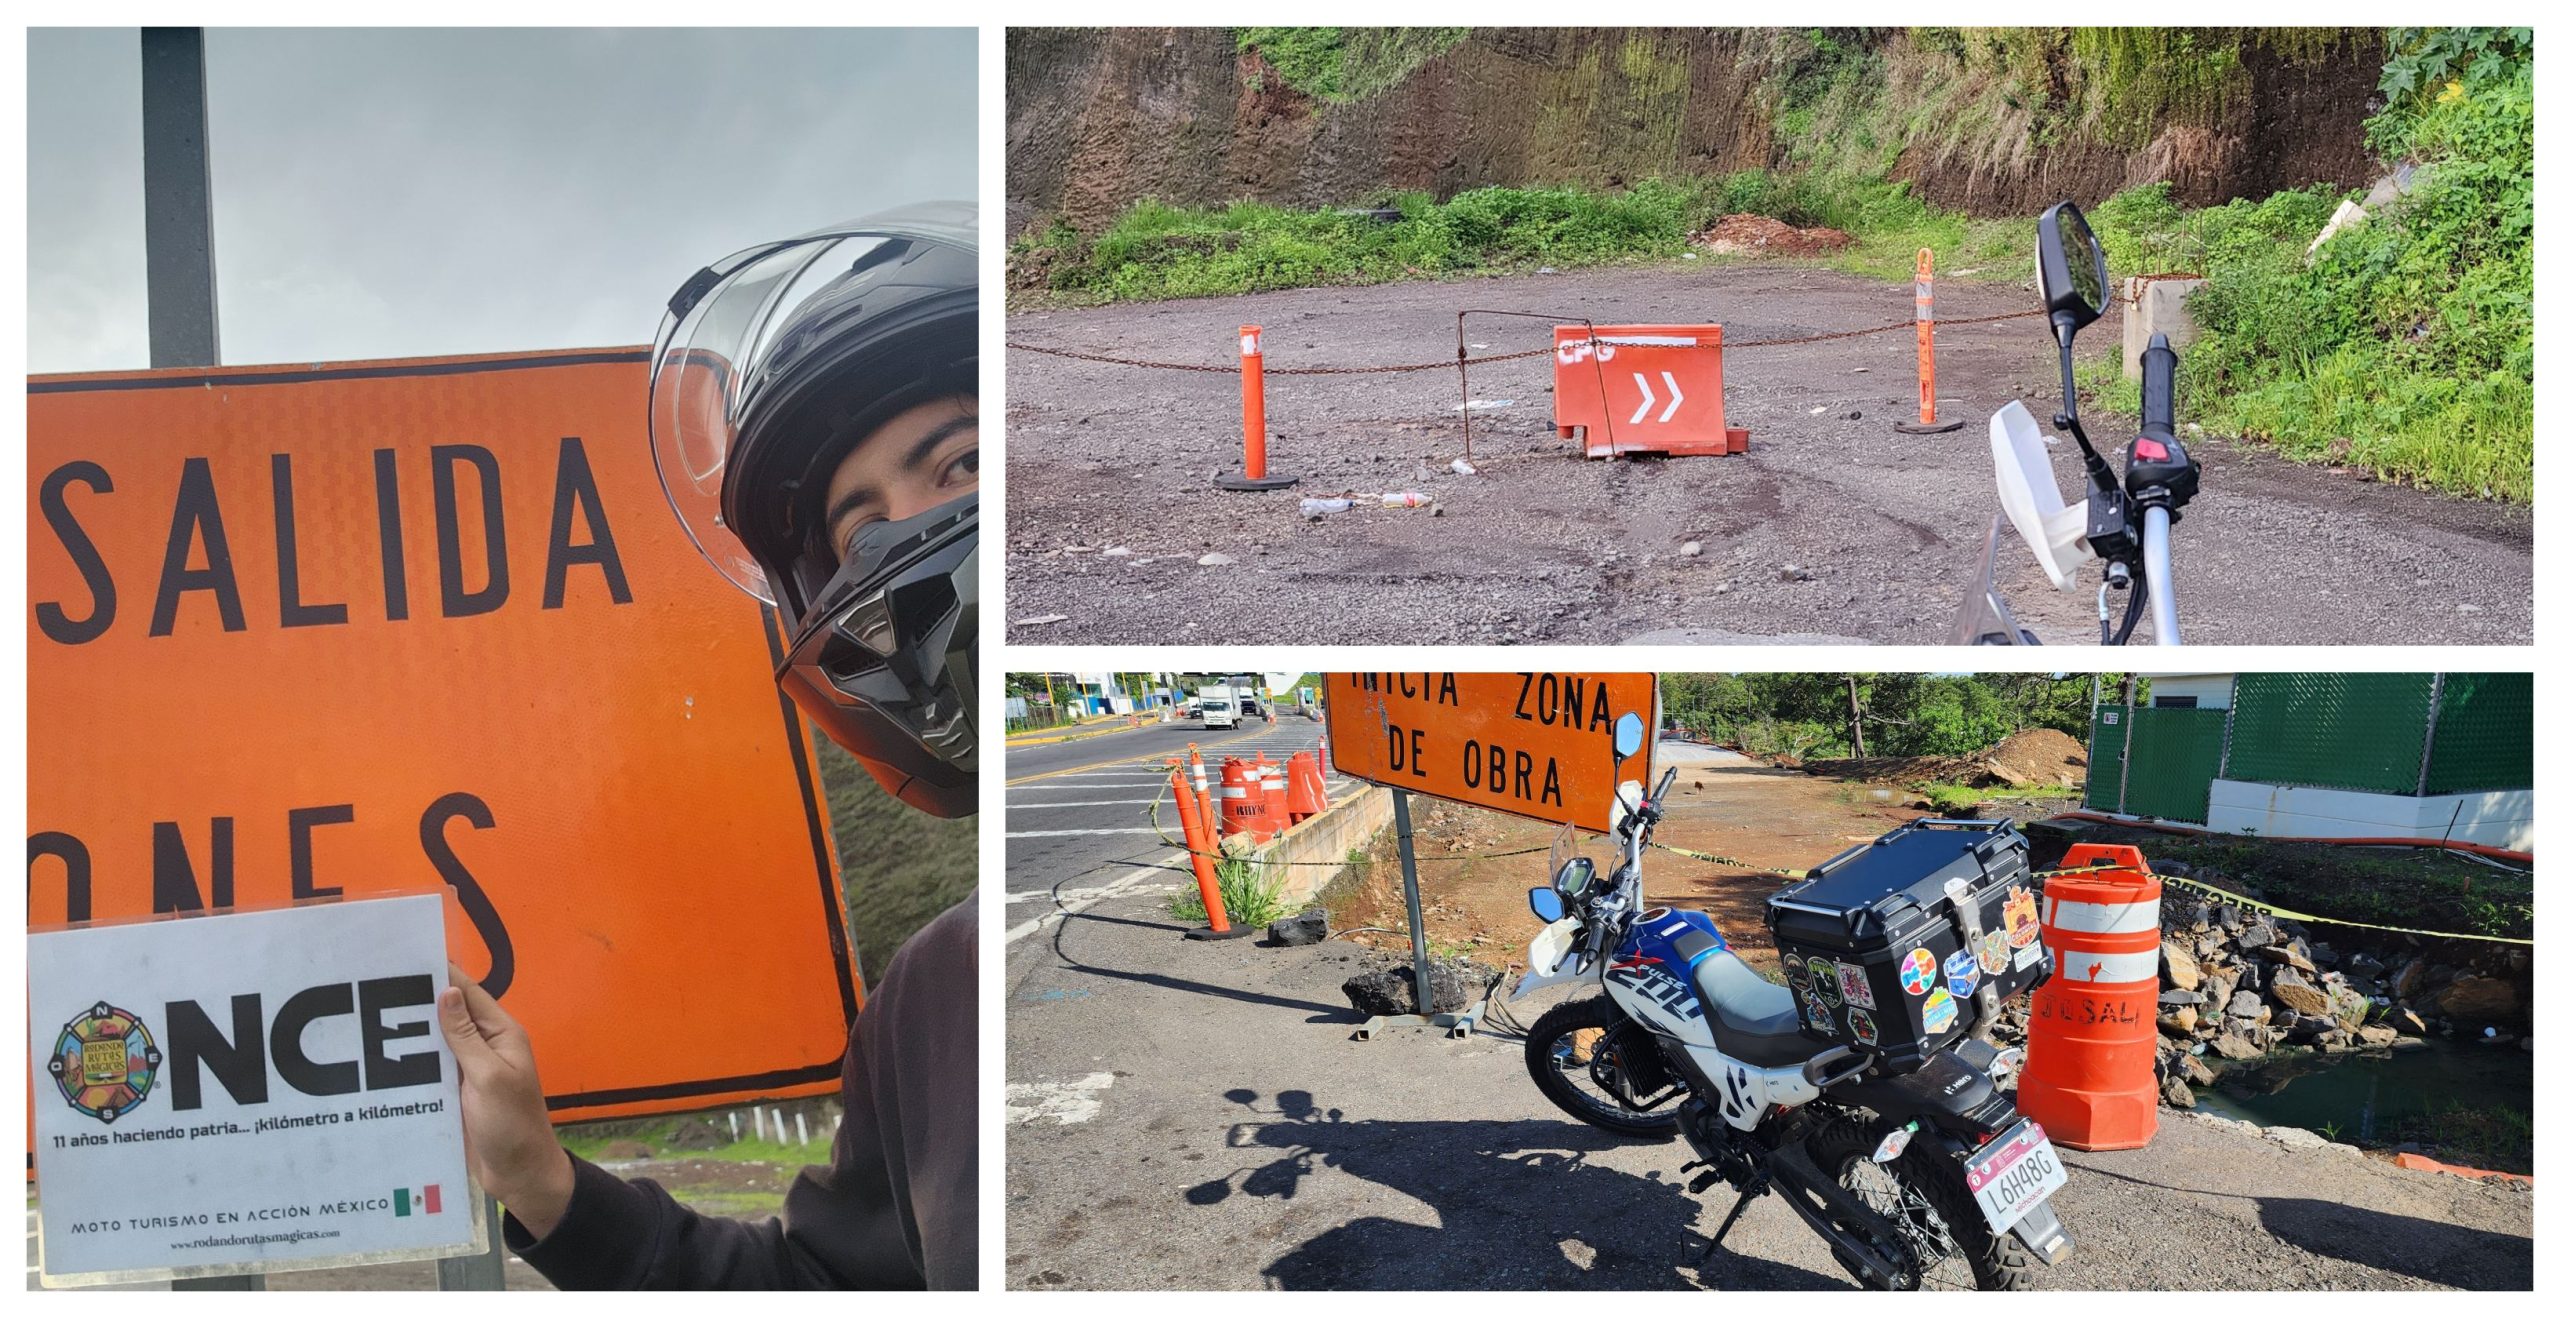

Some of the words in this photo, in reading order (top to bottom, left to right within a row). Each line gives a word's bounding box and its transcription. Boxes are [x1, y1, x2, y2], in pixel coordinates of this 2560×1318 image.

[35, 437, 633, 645] SALIDA
[1515, 672, 1612, 735] ZONA
[1388, 725, 1427, 777] DE
[1463, 740, 1562, 807] OBRA
[96, 1006, 108, 1016] N
[149, 1053, 158, 1062] E
[53, 1136, 66, 1148] 11
[71, 1133, 109, 1147] años
[113, 1127, 185, 1144] haciendo
[190, 1122, 250, 1140] patria...
[255, 1112, 339, 1134] ¡kilómetro
[344, 1112, 354, 1122] a
[359, 1099, 444, 1120] kilómetro!
[103, 1110, 114, 1119] S
[1987, 1150, 2052, 1214] L6H48G
[71, 1220, 121, 1233] MOTO
[130, 1214, 208, 1230] TURISMO
[217, 1212, 239, 1224] EN
[247, 1204, 310, 1221] ACCIÓN
[319, 1198, 389, 1215] MÉXICO
[171, 1228, 340, 1249] www.rodandorutasmagicas.com
